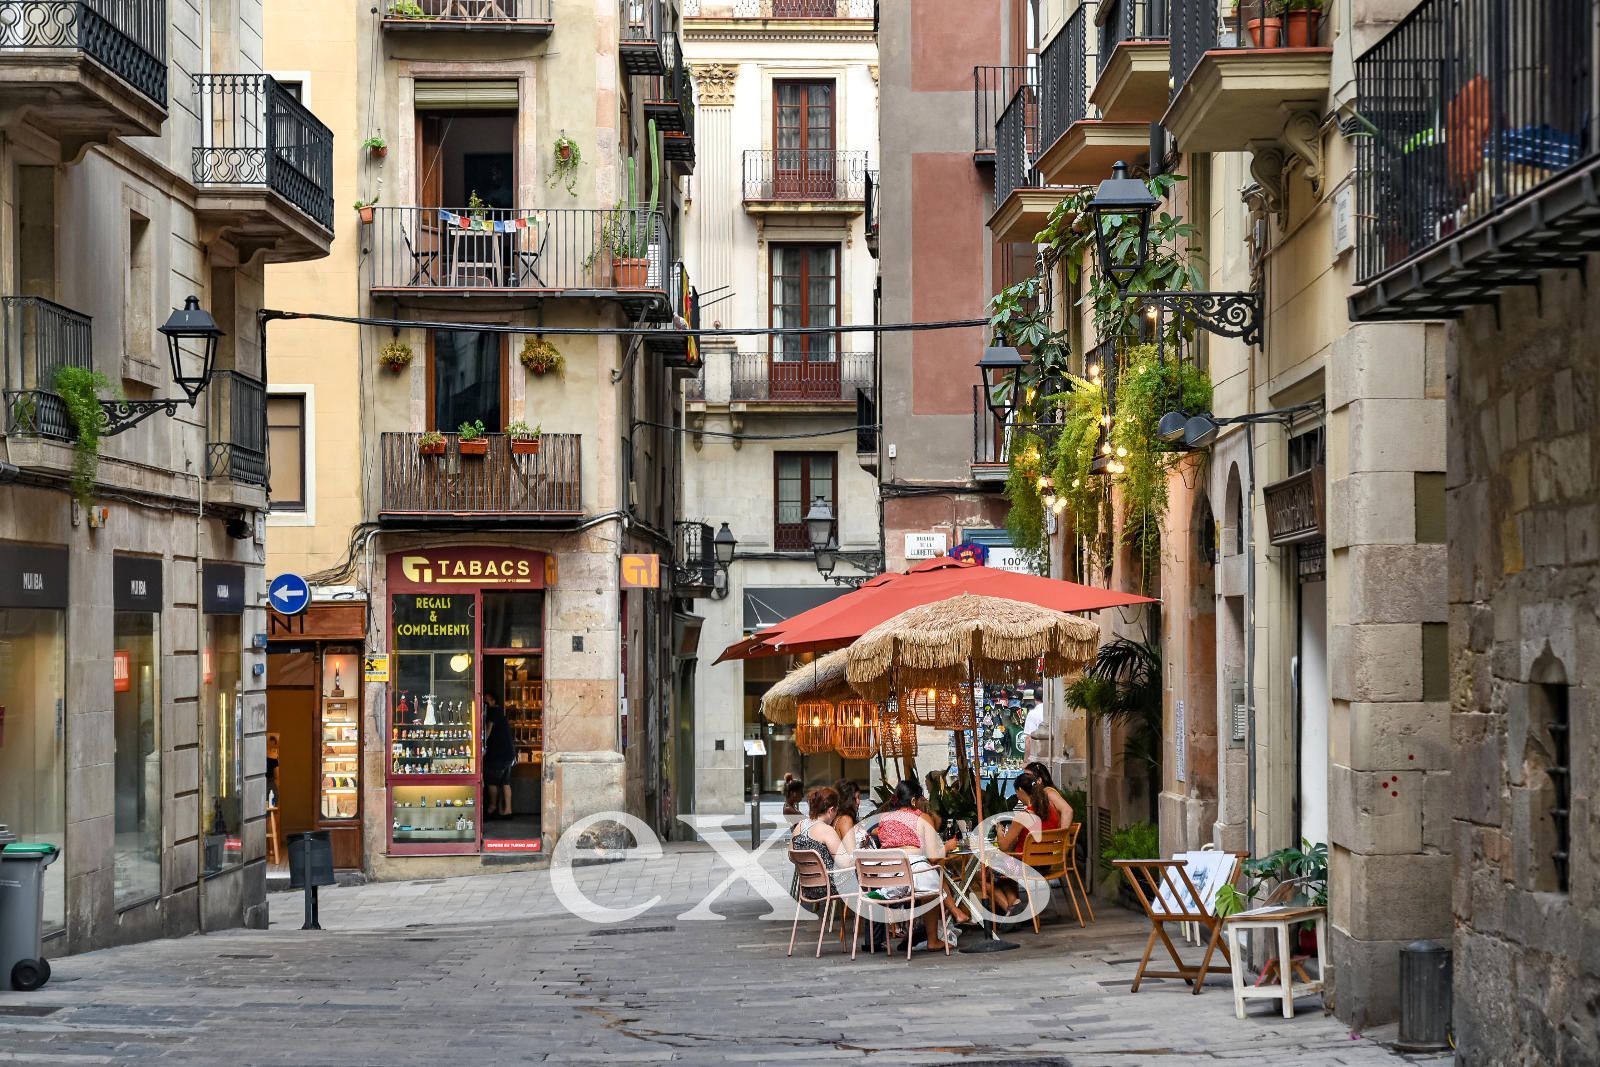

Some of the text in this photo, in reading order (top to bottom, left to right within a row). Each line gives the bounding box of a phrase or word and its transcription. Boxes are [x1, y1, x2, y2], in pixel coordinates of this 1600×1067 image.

[437, 560, 530, 576] TABACS
[416, 597, 451, 609] REGALS
[429, 610, 438, 622] &
[397, 624, 470, 636] COMPLEMENTS
